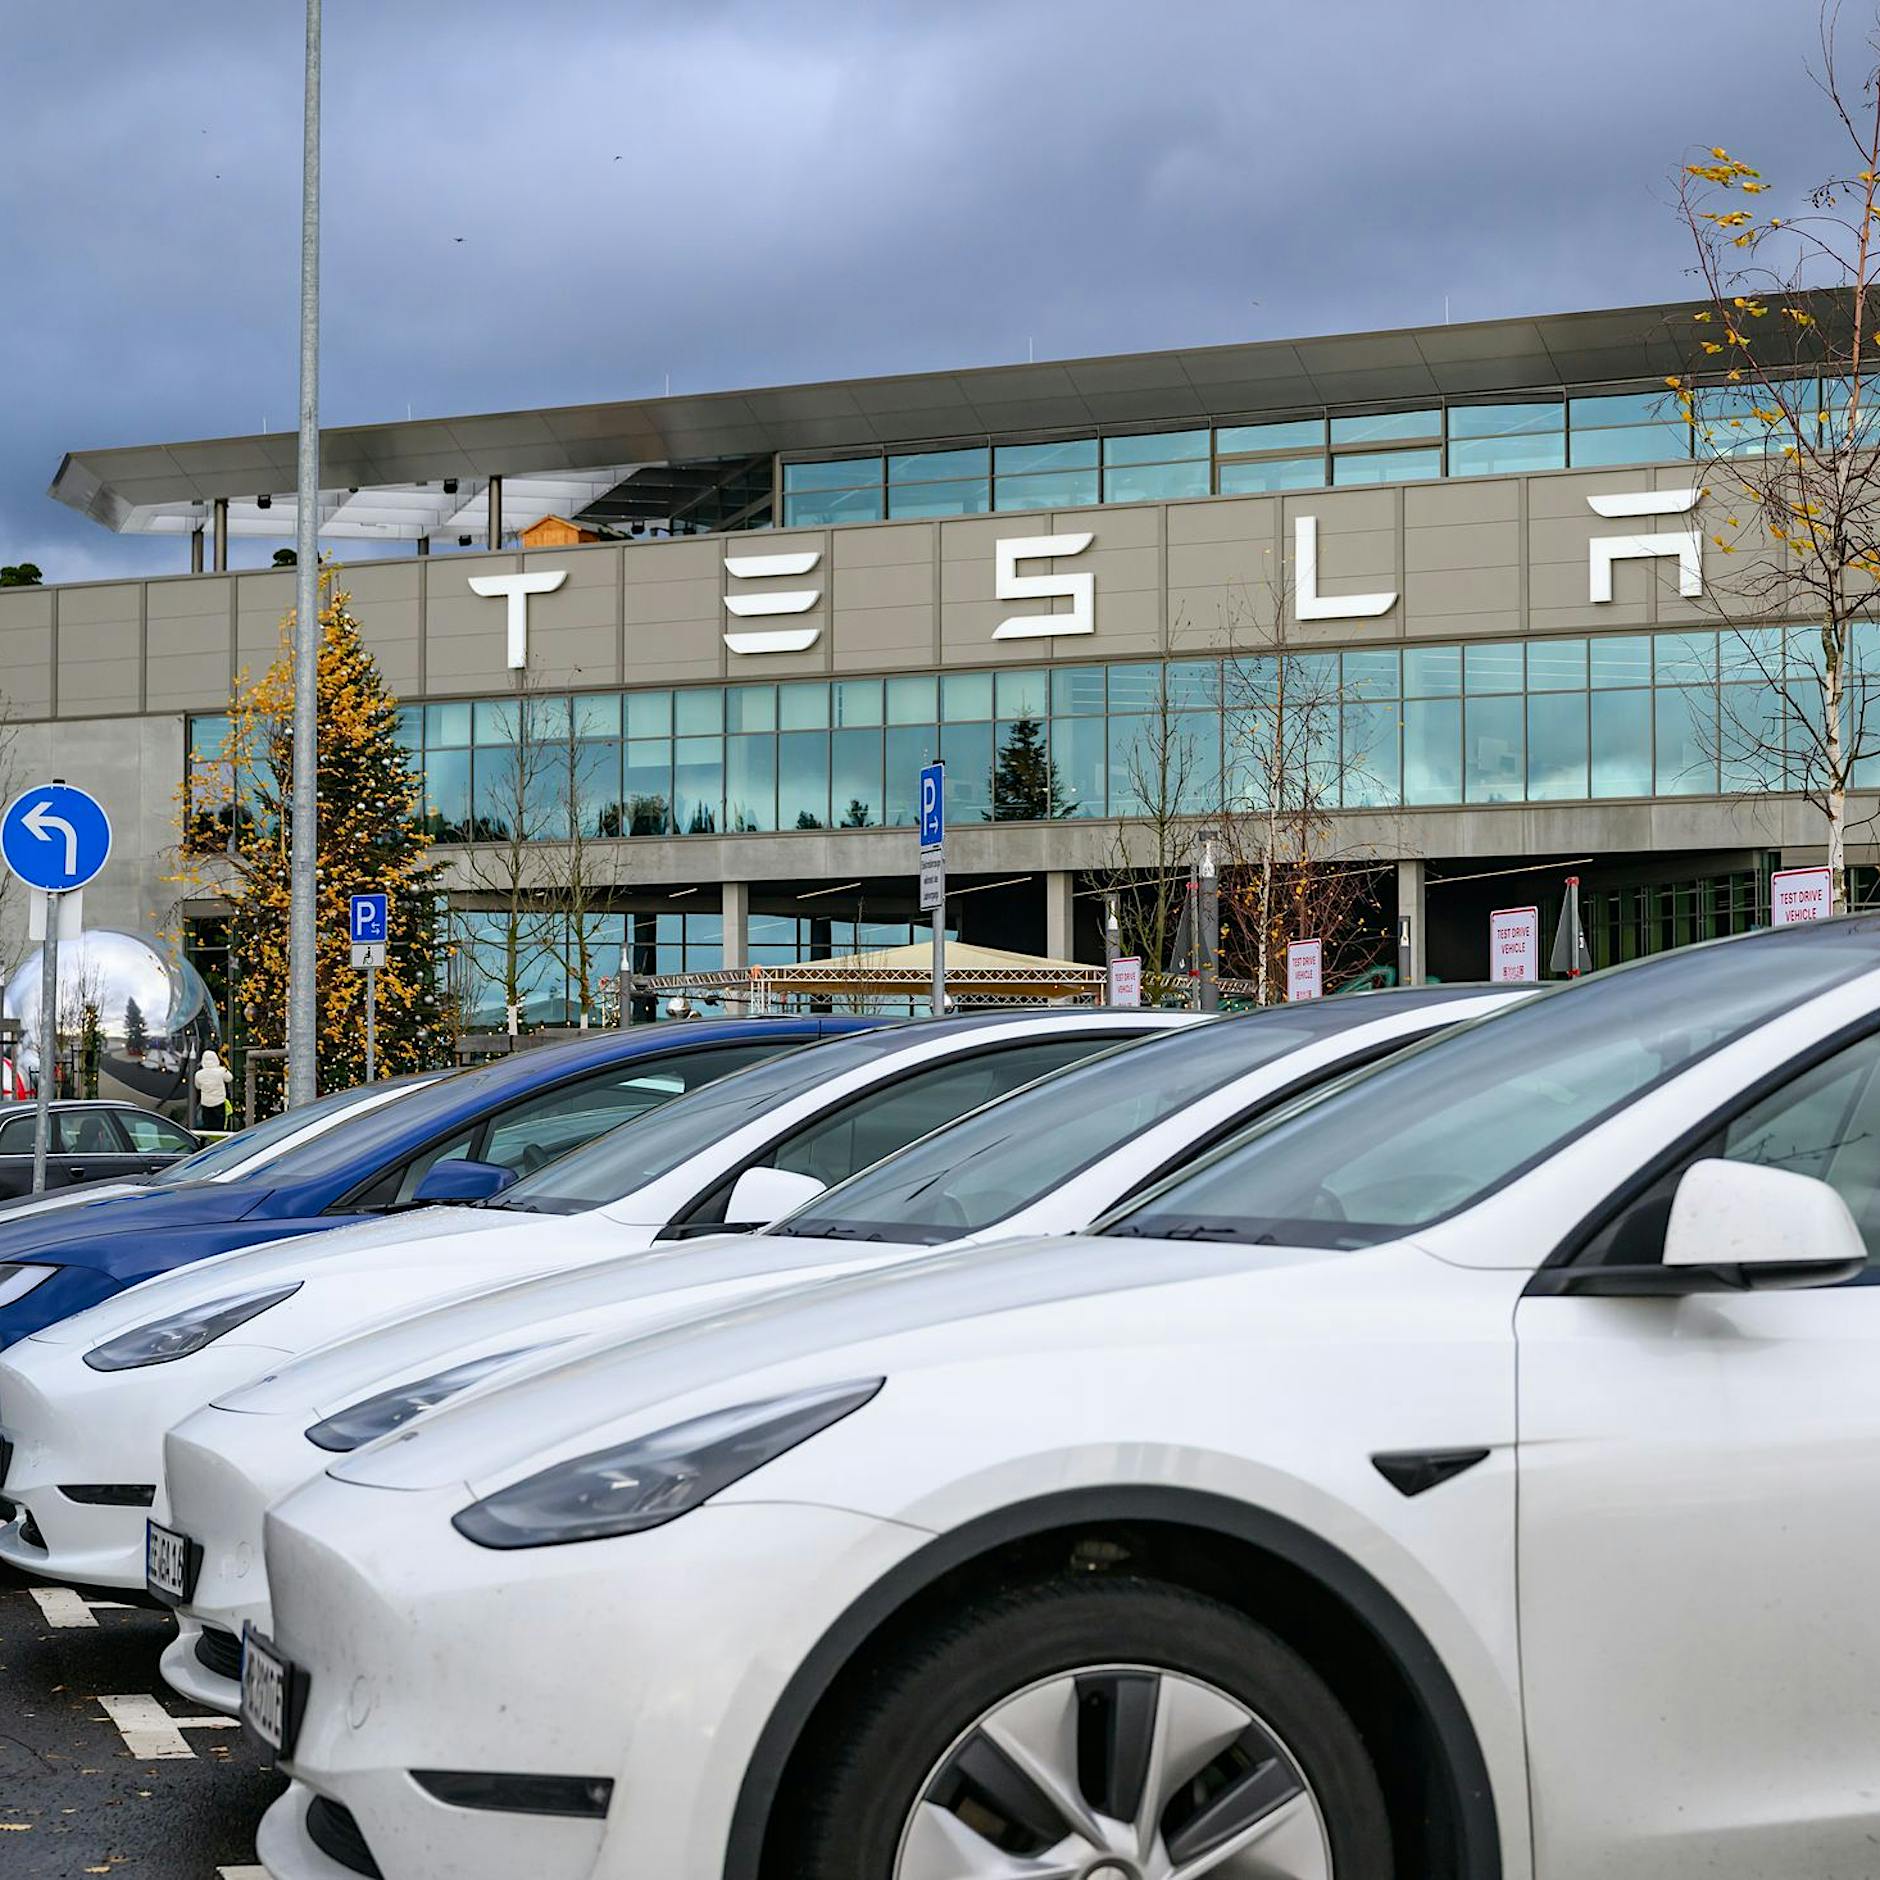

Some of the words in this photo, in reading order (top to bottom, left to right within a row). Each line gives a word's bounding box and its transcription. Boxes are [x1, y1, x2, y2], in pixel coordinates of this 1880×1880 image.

[468, 488, 1702, 670] TESLA
[923, 777, 936, 837] P
[1780, 892, 1797, 904] TEST
[1799, 889, 1822, 903] DRIVE
[356, 901, 376, 936] P
[1785, 907, 1817, 921] VEHICLE
[1497, 928, 1511, 940] TEST
[1512, 926, 1530, 938] DRIVE
[1502, 942, 1526, 954] VEHICLE
